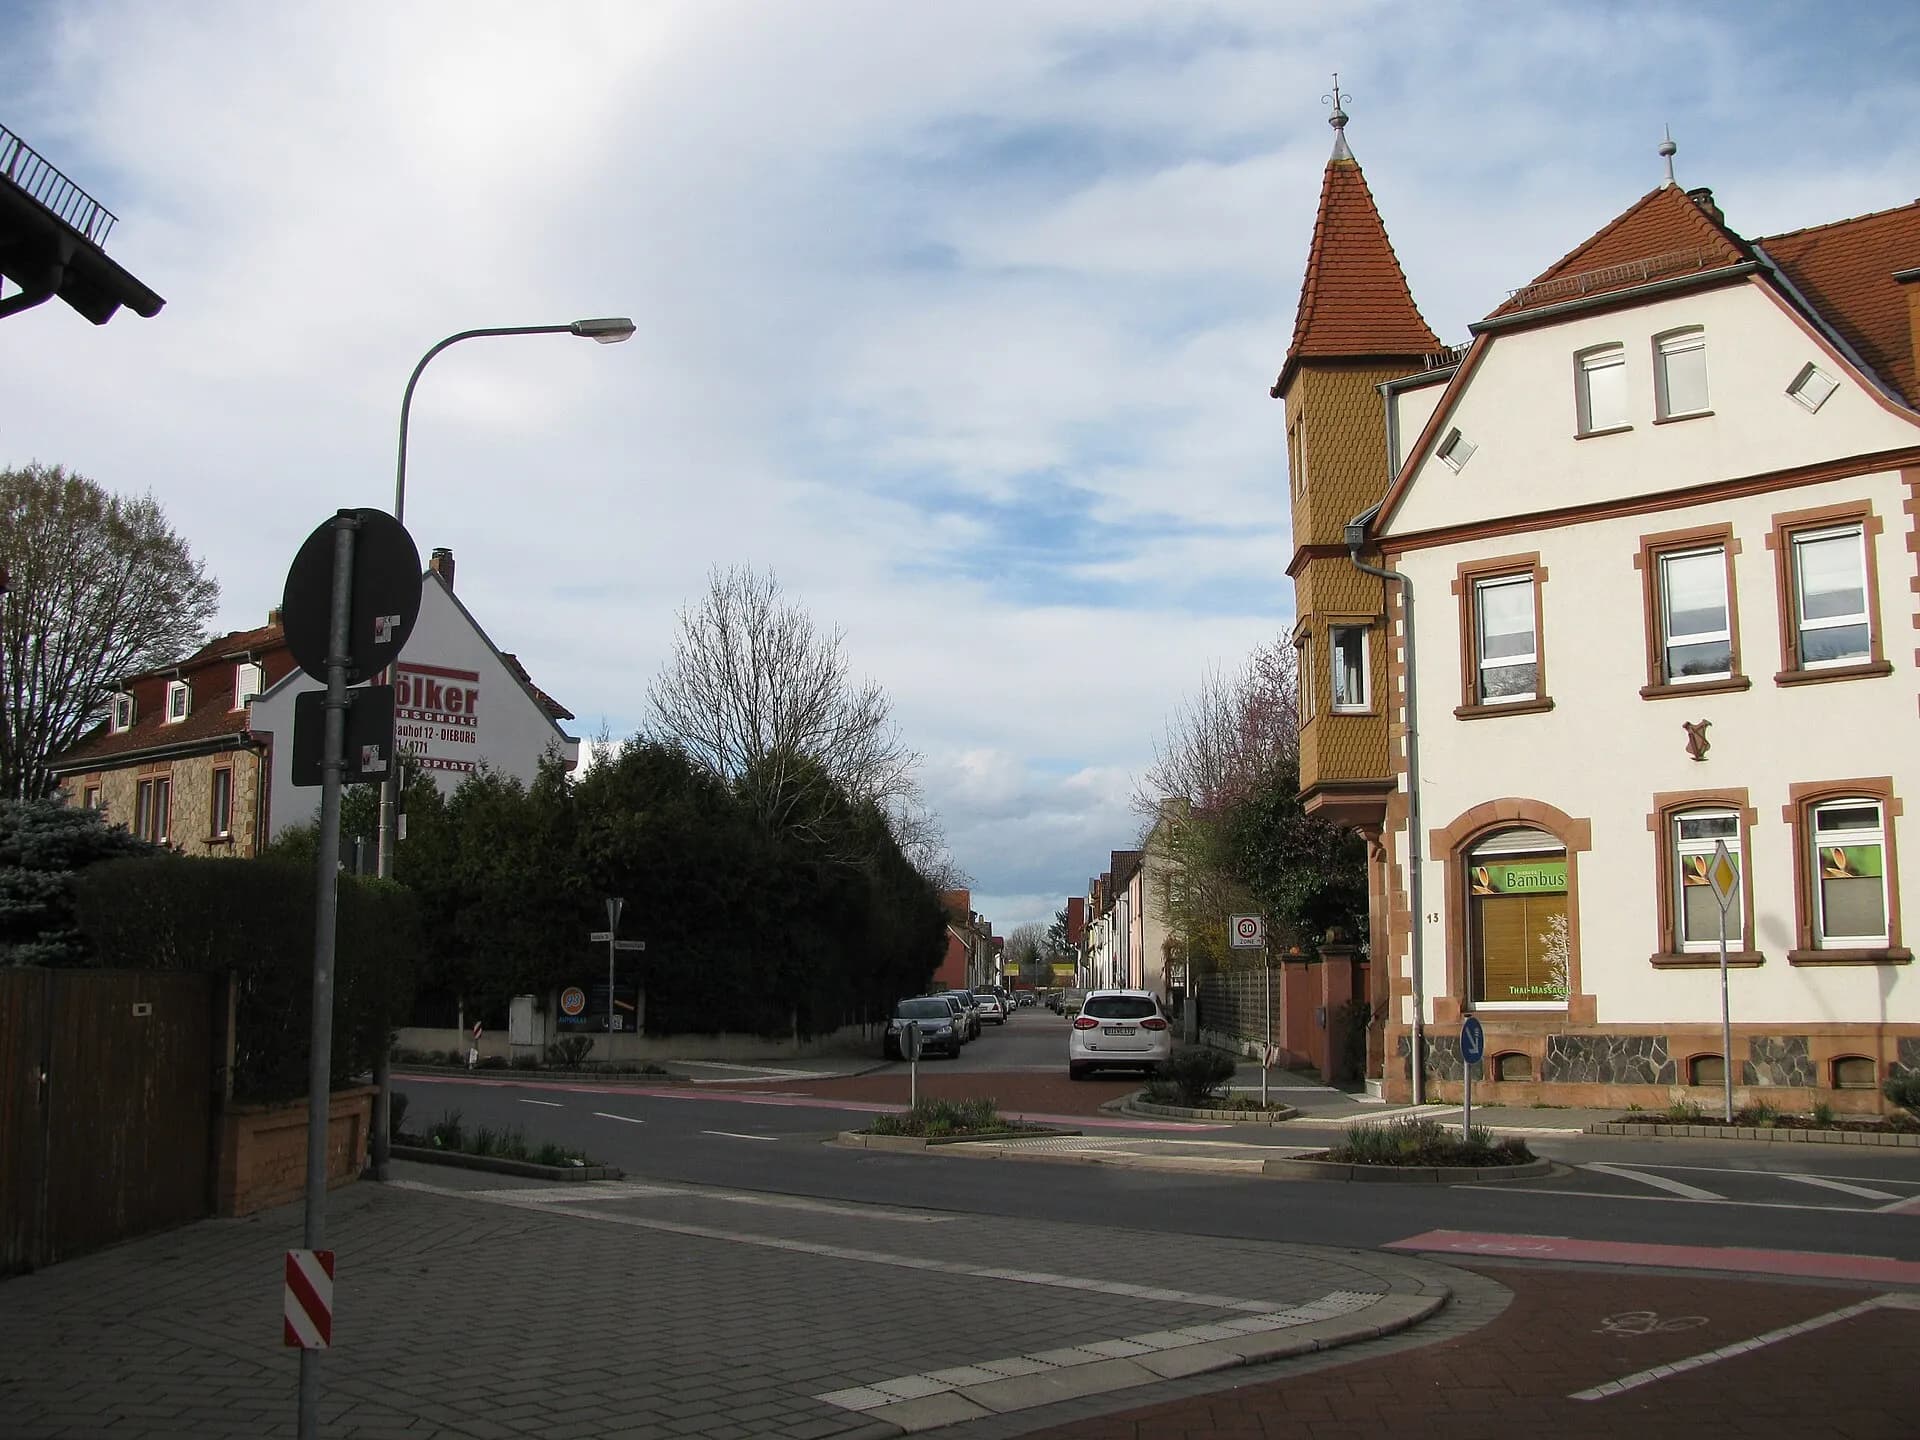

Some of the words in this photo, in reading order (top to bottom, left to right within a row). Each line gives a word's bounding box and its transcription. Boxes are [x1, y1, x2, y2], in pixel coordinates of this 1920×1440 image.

[400, 709, 477, 726] RSCHULE
[397, 725, 423, 739] auhof
[424, 727, 434, 739] 12
[440, 728, 476, 744] DIEBURG
[417, 758, 475, 772] SPLATZ
[1507, 870, 1565, 888] Bambus
[1426, 912, 1439, 924] 13
[1241, 923, 1254, 933] 30
